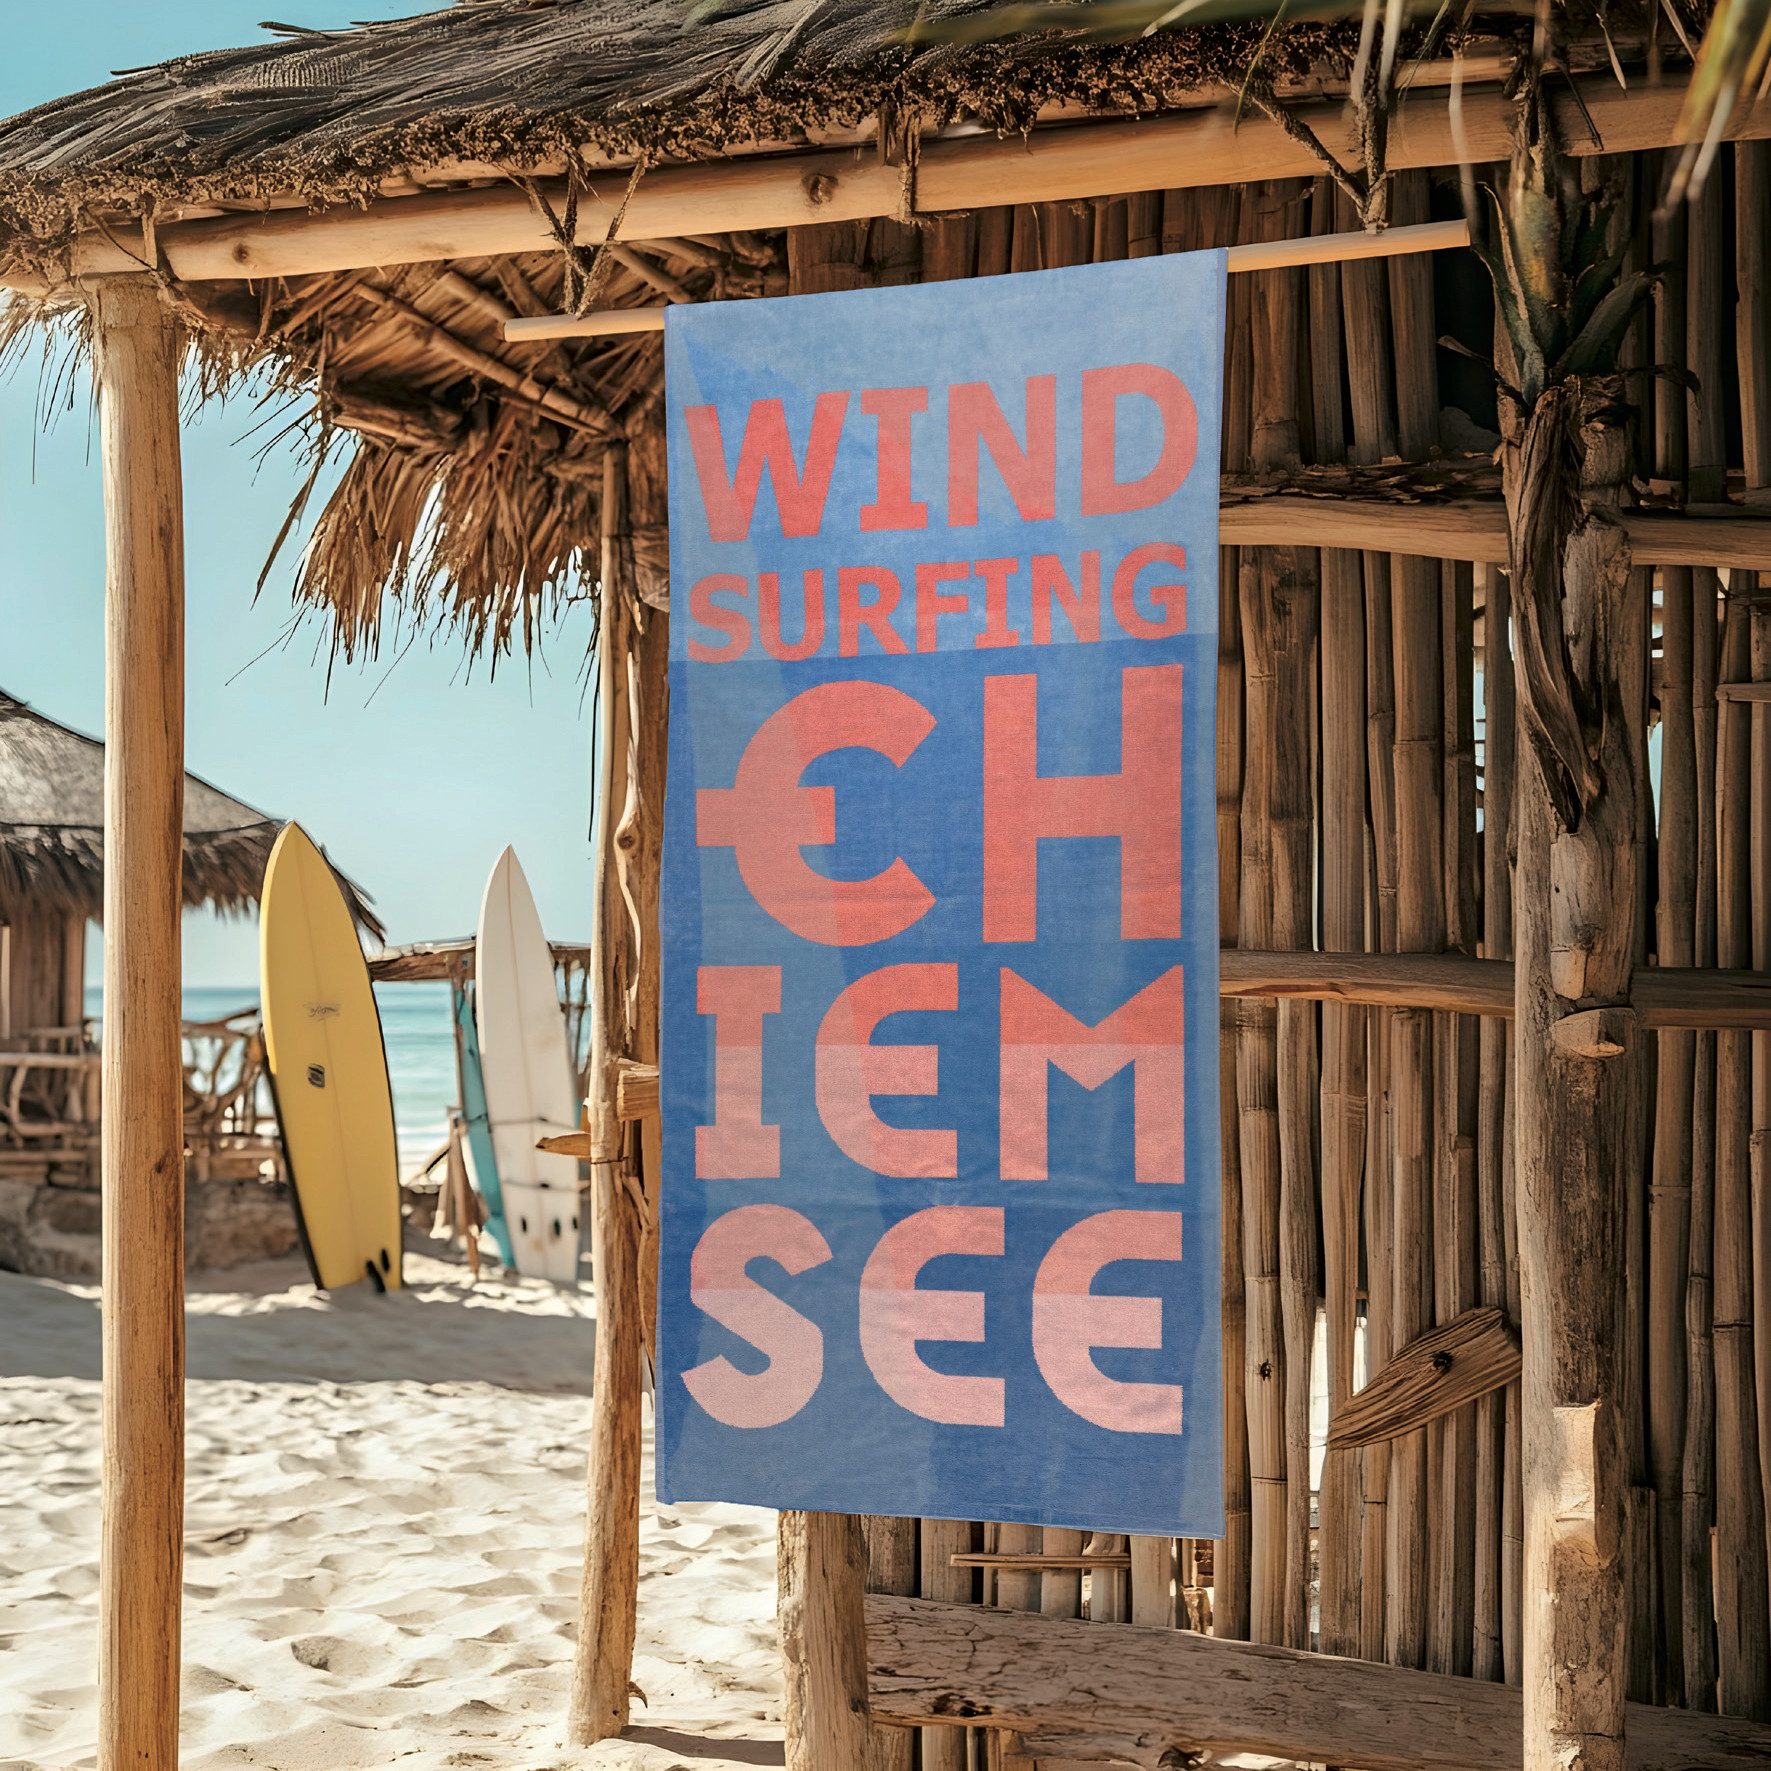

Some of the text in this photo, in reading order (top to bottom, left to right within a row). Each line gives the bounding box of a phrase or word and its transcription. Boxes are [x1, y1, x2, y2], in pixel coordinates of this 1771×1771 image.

[685, 363, 1198, 542] WIND
[686, 542, 1188, 664] SURFING
[695, 963, 1185, 1184] IEM
[681, 1204, 1183, 1434] SEE
